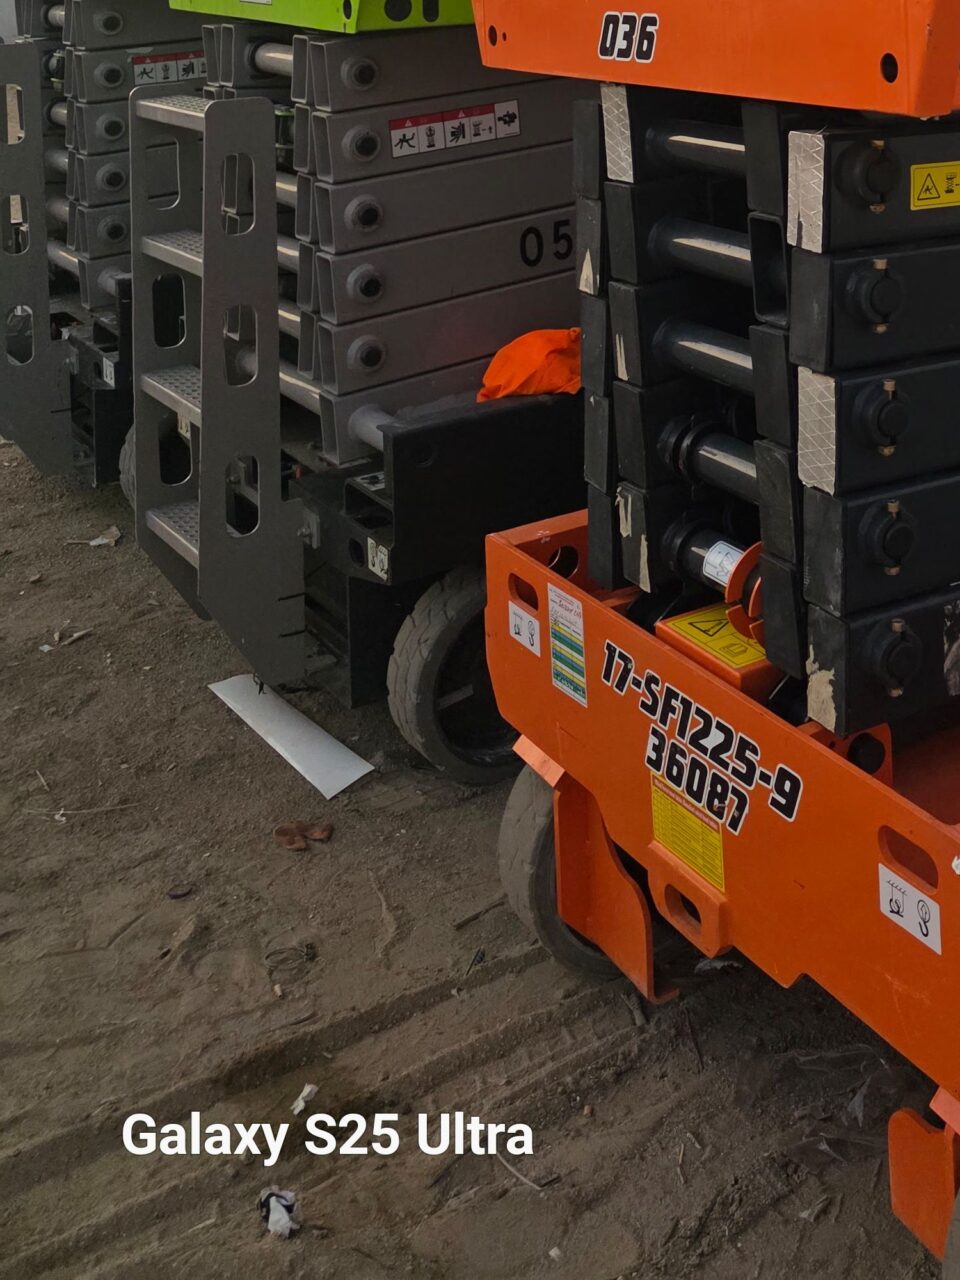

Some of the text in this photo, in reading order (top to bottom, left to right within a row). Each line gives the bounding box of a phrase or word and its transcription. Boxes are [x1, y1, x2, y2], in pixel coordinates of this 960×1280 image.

[598, 11, 659, 63] 036
[602, 639, 803, 822] 17-SF1225-9
[645, 723, 749, 836] 36087
